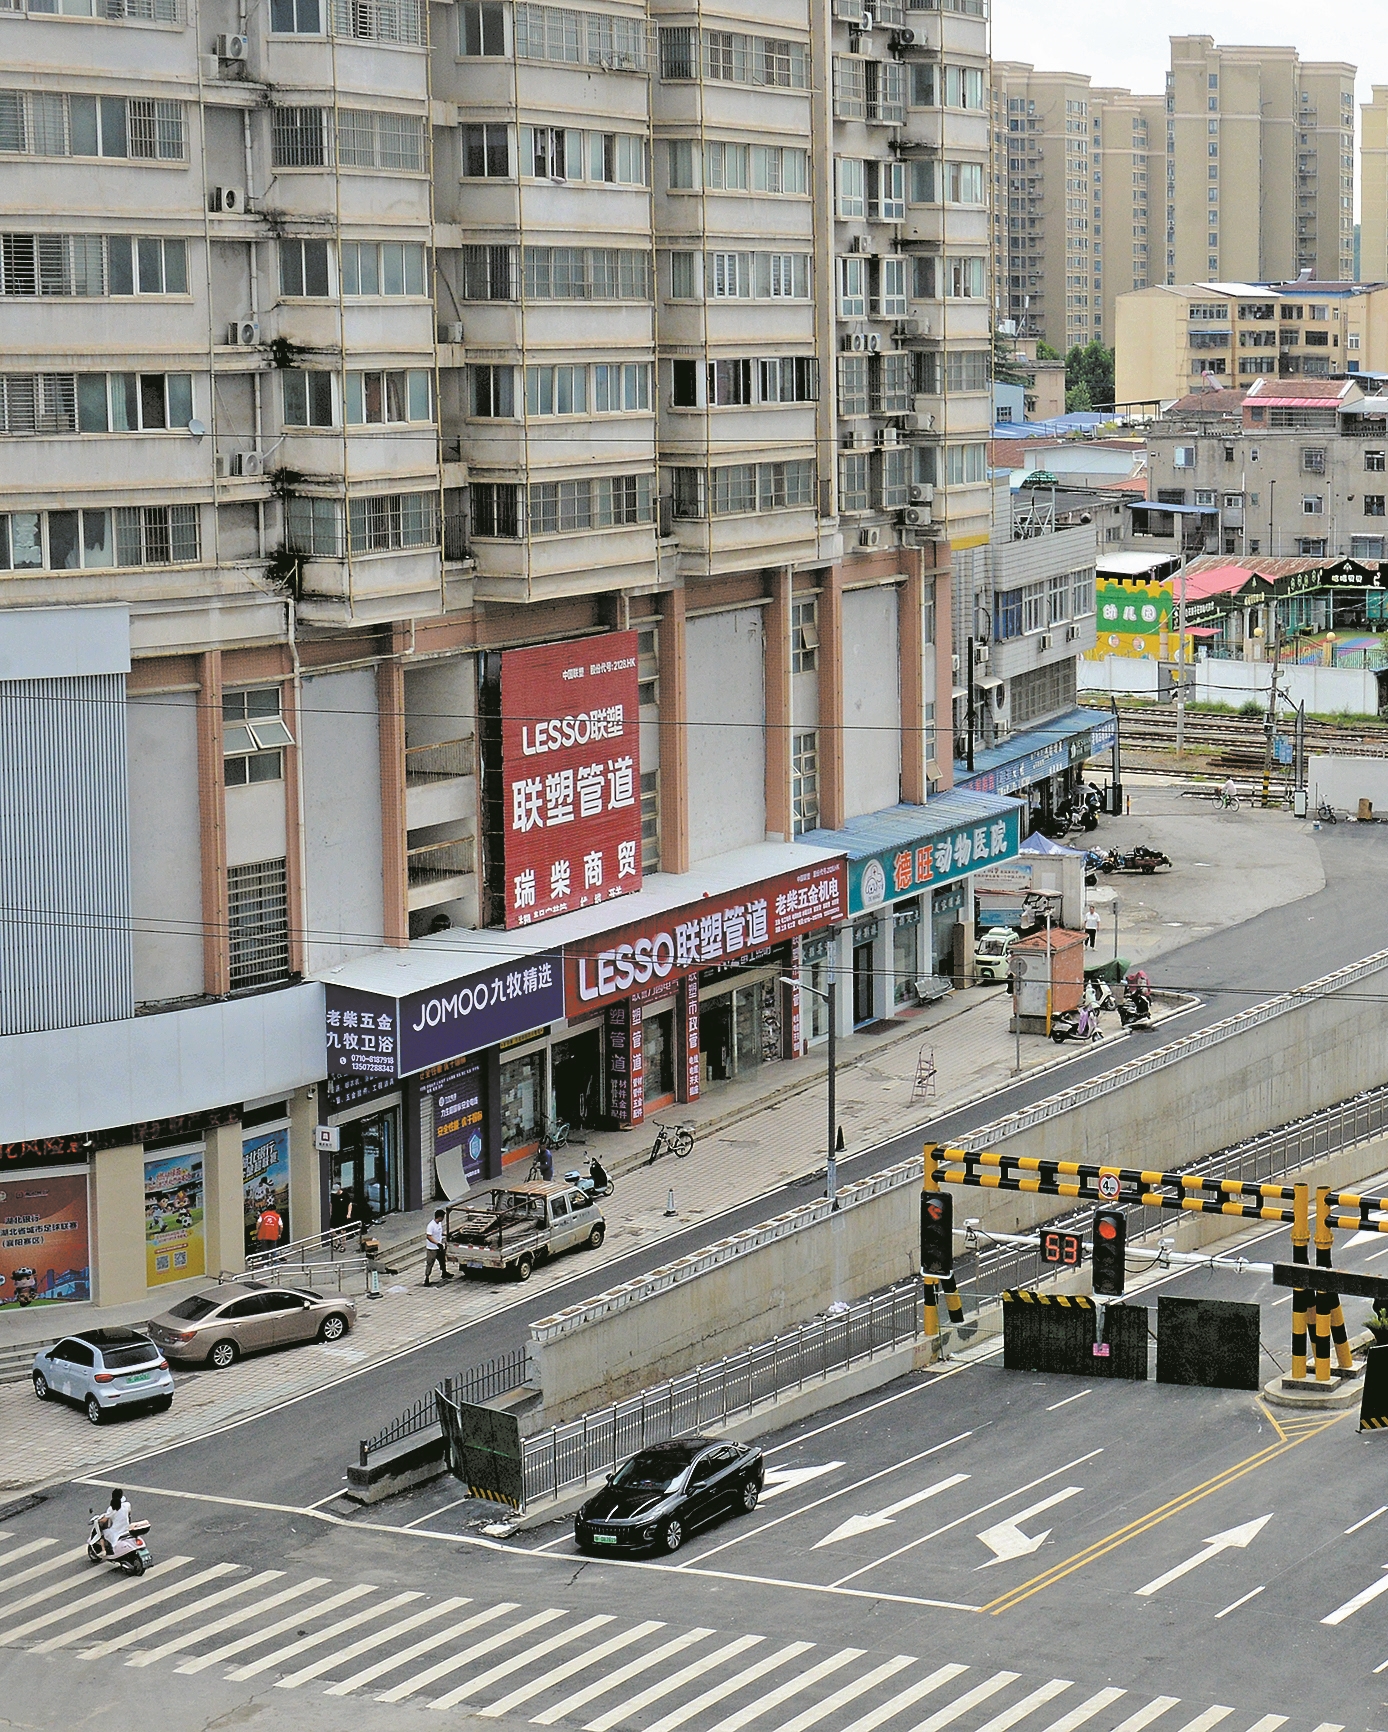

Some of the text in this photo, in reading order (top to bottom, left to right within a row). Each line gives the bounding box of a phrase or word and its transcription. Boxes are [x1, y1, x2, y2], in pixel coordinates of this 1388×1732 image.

[1102, 603, 1157, 622] 幼儿园
[512, 756, 635, 832] 联塑管道
[894, 820, 1008, 892] 德旺动物医院
[514, 841, 636, 909] 瑞柴商贸
[775, 877, 840, 916] 老柴五金机电
[326, 1009, 393, 1032] 老柴五金
[326, 1031, 394, 1054] 九牧卫浴
[1102, 1180, 1116, 1192] 4m
